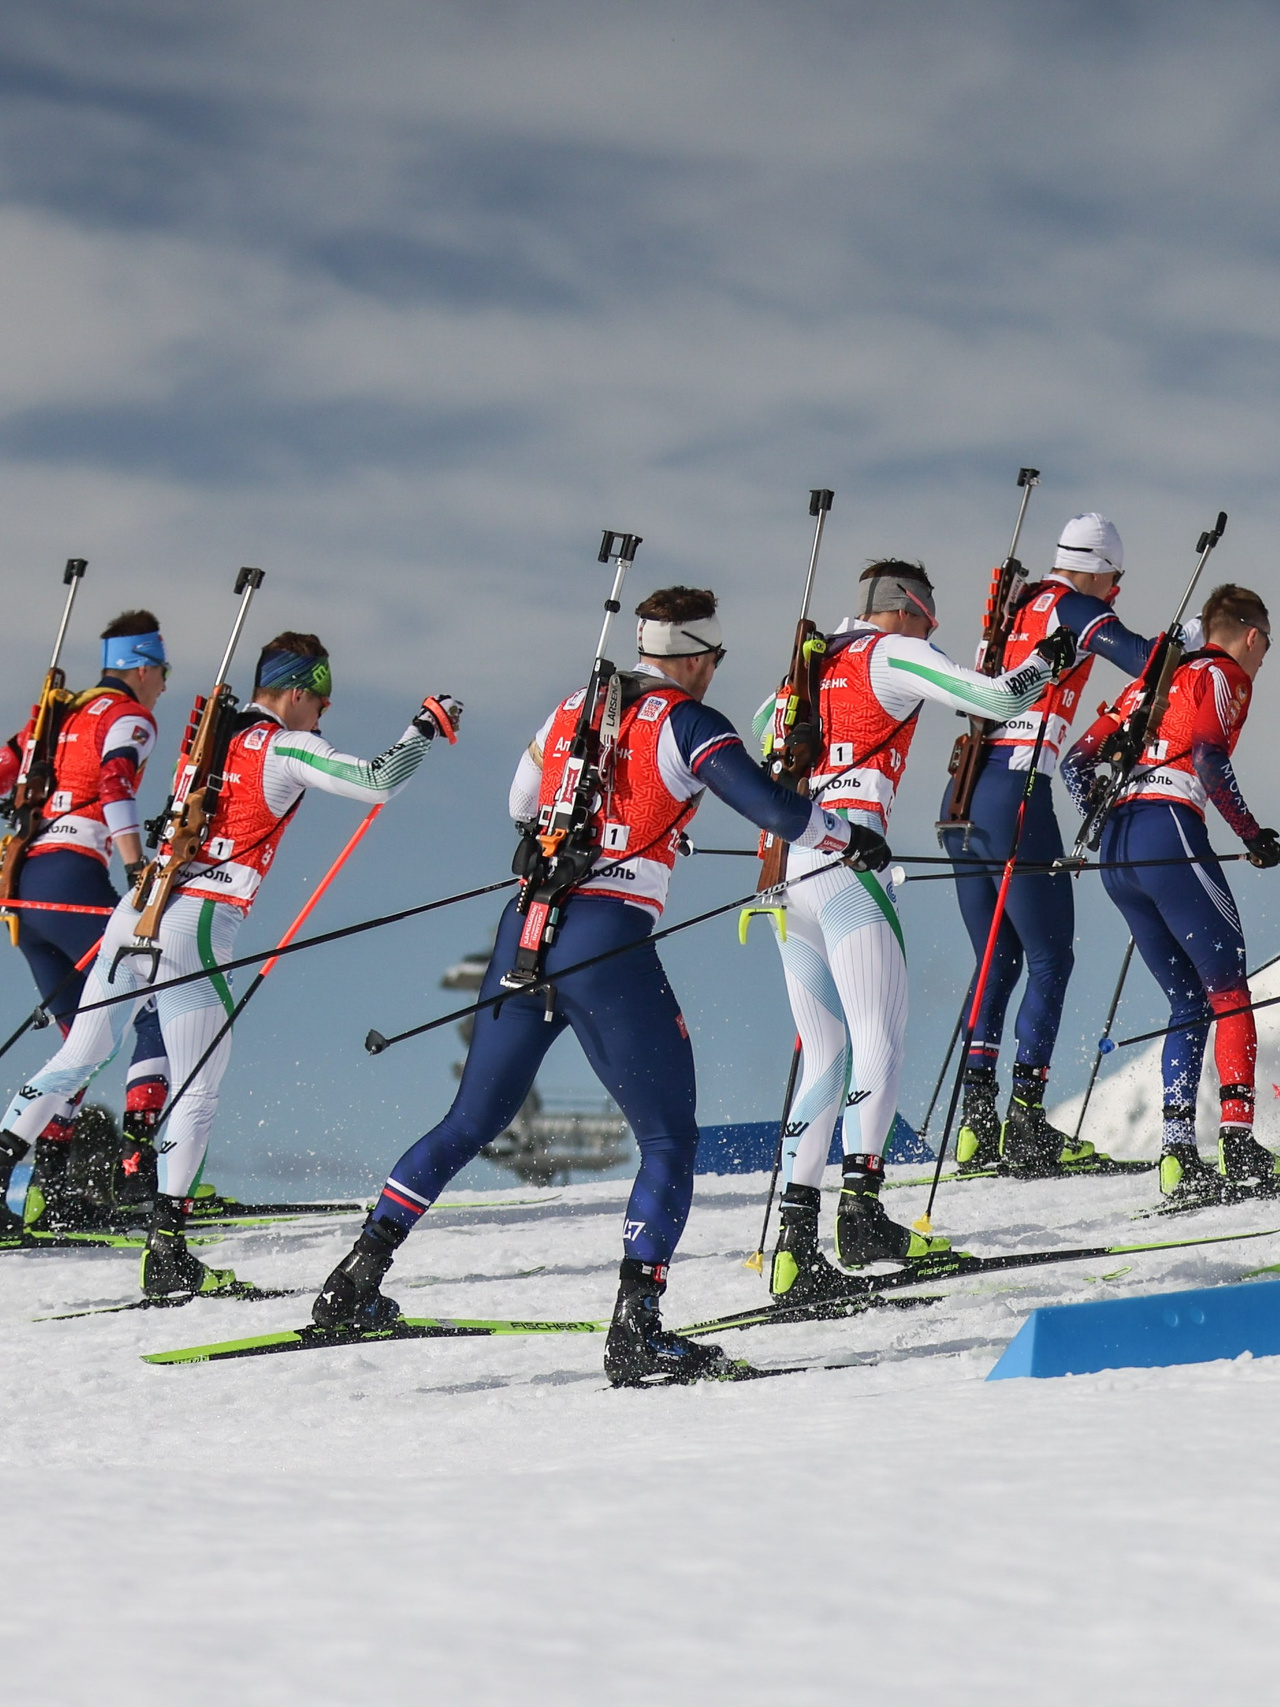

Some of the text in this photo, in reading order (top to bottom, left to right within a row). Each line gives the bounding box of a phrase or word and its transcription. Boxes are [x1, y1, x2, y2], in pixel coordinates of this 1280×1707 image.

[1062, 688, 1074, 708] 18
[606, 687, 619, 727] LARSEN
[836, 746, 843, 762] 1
[1026, 767, 1037, 797] LEKI
[609, 828, 618, 845] 1
[216, 841, 224, 856] 1
[917, 1263, 959, 1277] FISCHER
[510, 1321, 580, 1331] FISCHER
